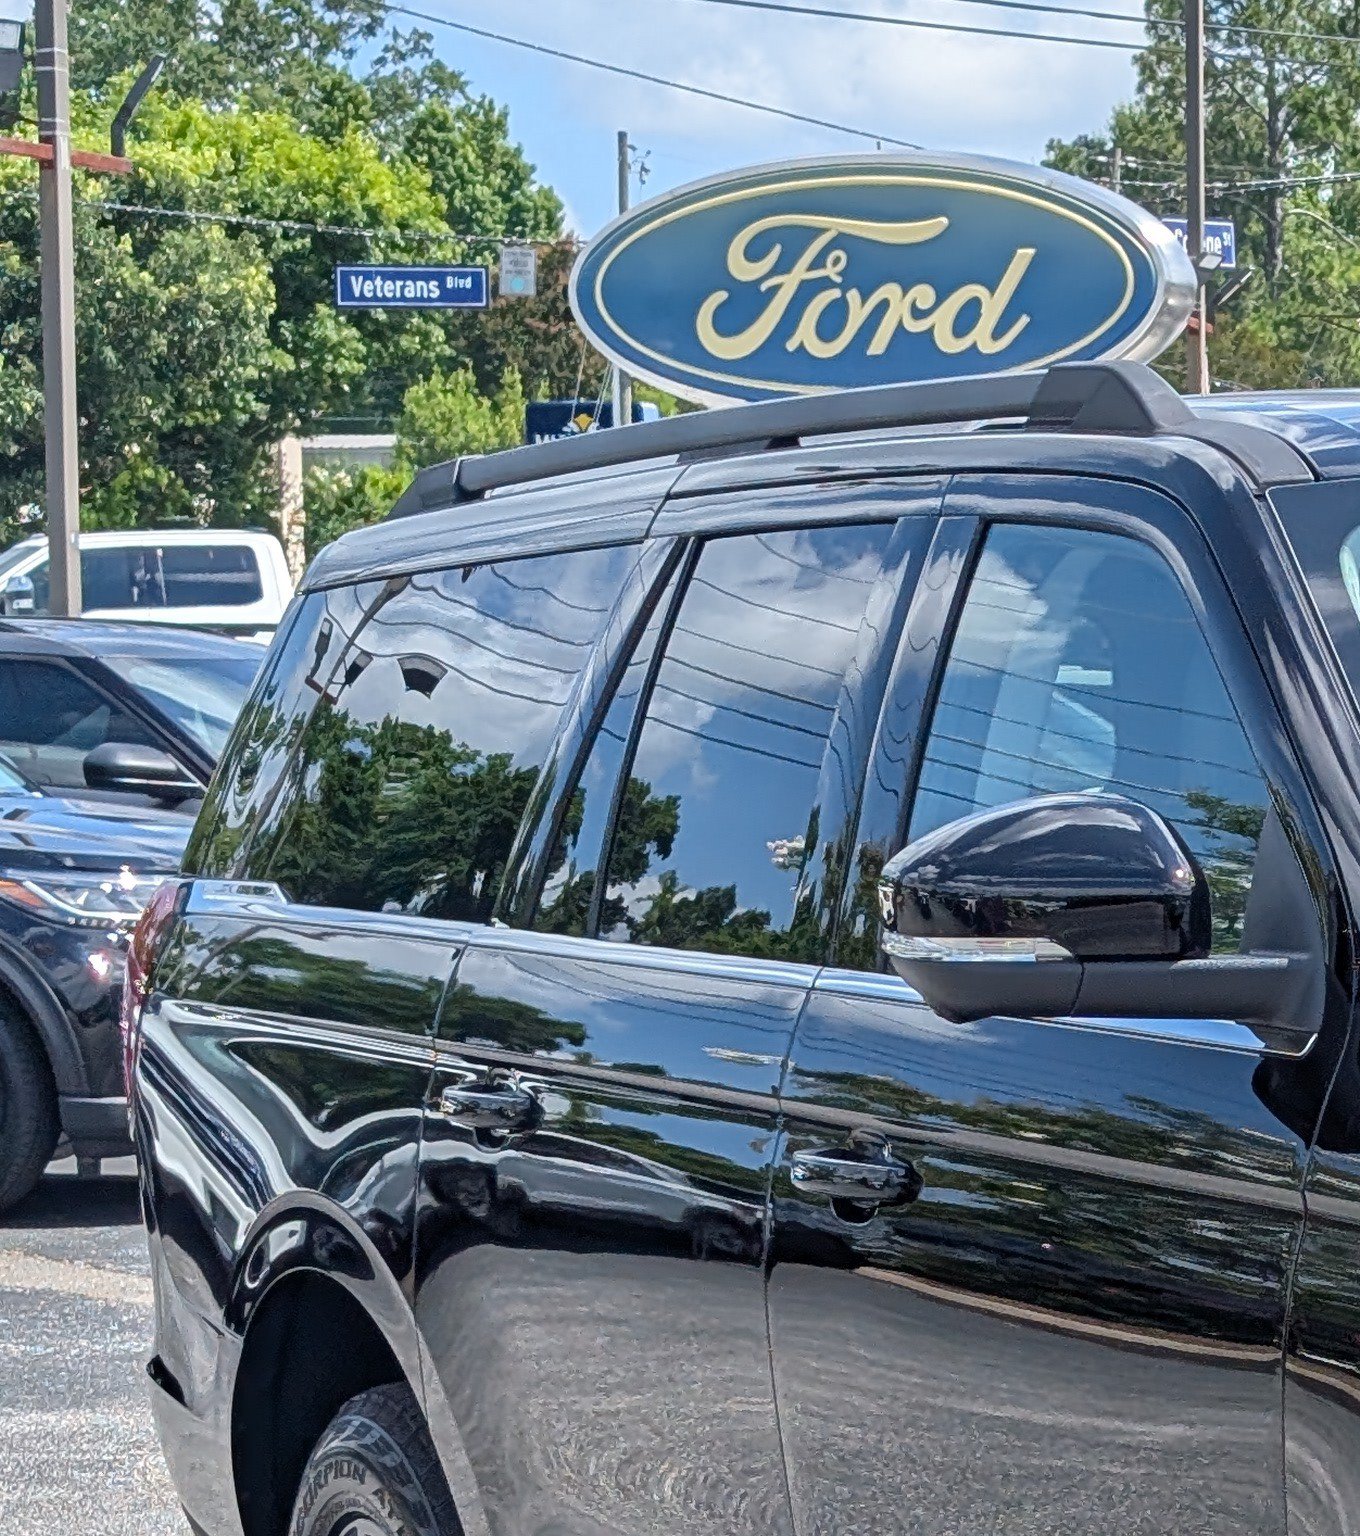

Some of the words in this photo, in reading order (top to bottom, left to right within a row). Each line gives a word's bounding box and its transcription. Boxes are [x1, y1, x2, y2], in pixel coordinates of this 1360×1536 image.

[350, 275, 440, 299] Veterans
[446, 275, 472, 289] Blvd
[695, 213, 1037, 361] Ford
